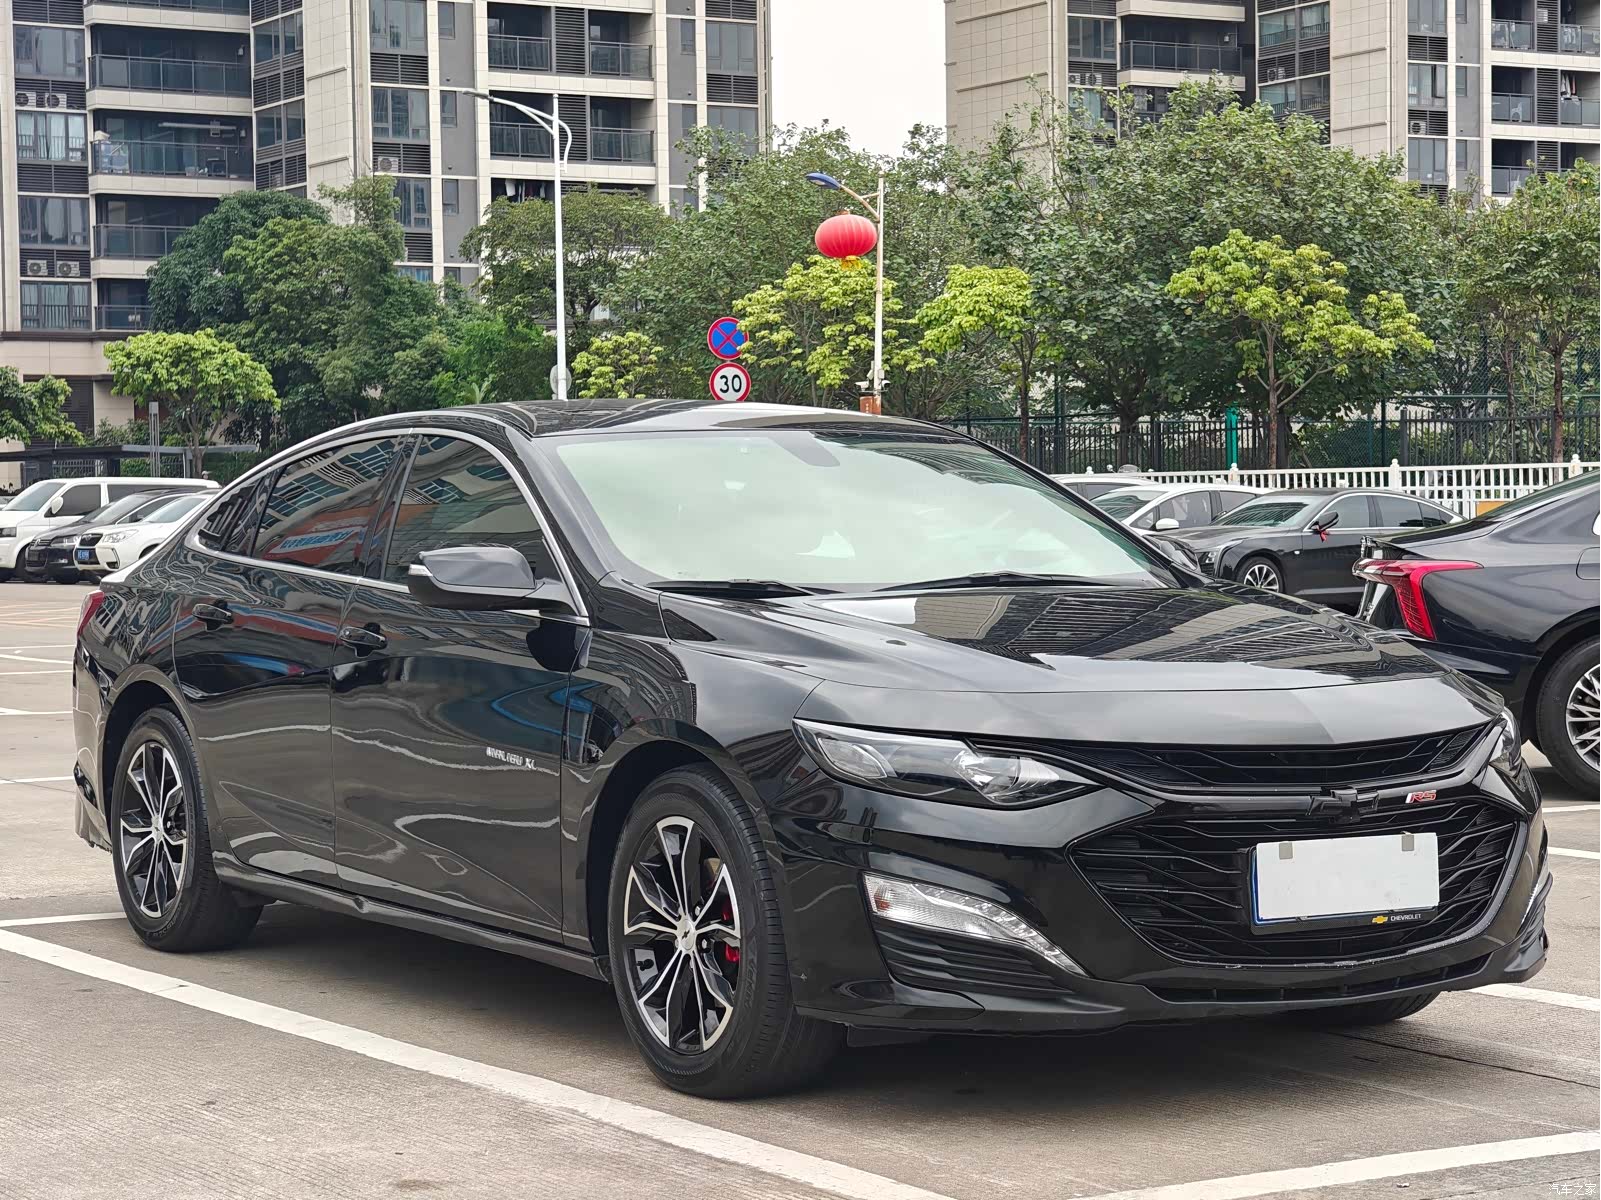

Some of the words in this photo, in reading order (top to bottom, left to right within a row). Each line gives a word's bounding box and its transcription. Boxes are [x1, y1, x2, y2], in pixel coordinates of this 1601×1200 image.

[719, 374, 742, 393] 30
[1406, 790, 1437, 803] RS
[1390, 913, 1421, 922] CHEVROLET
